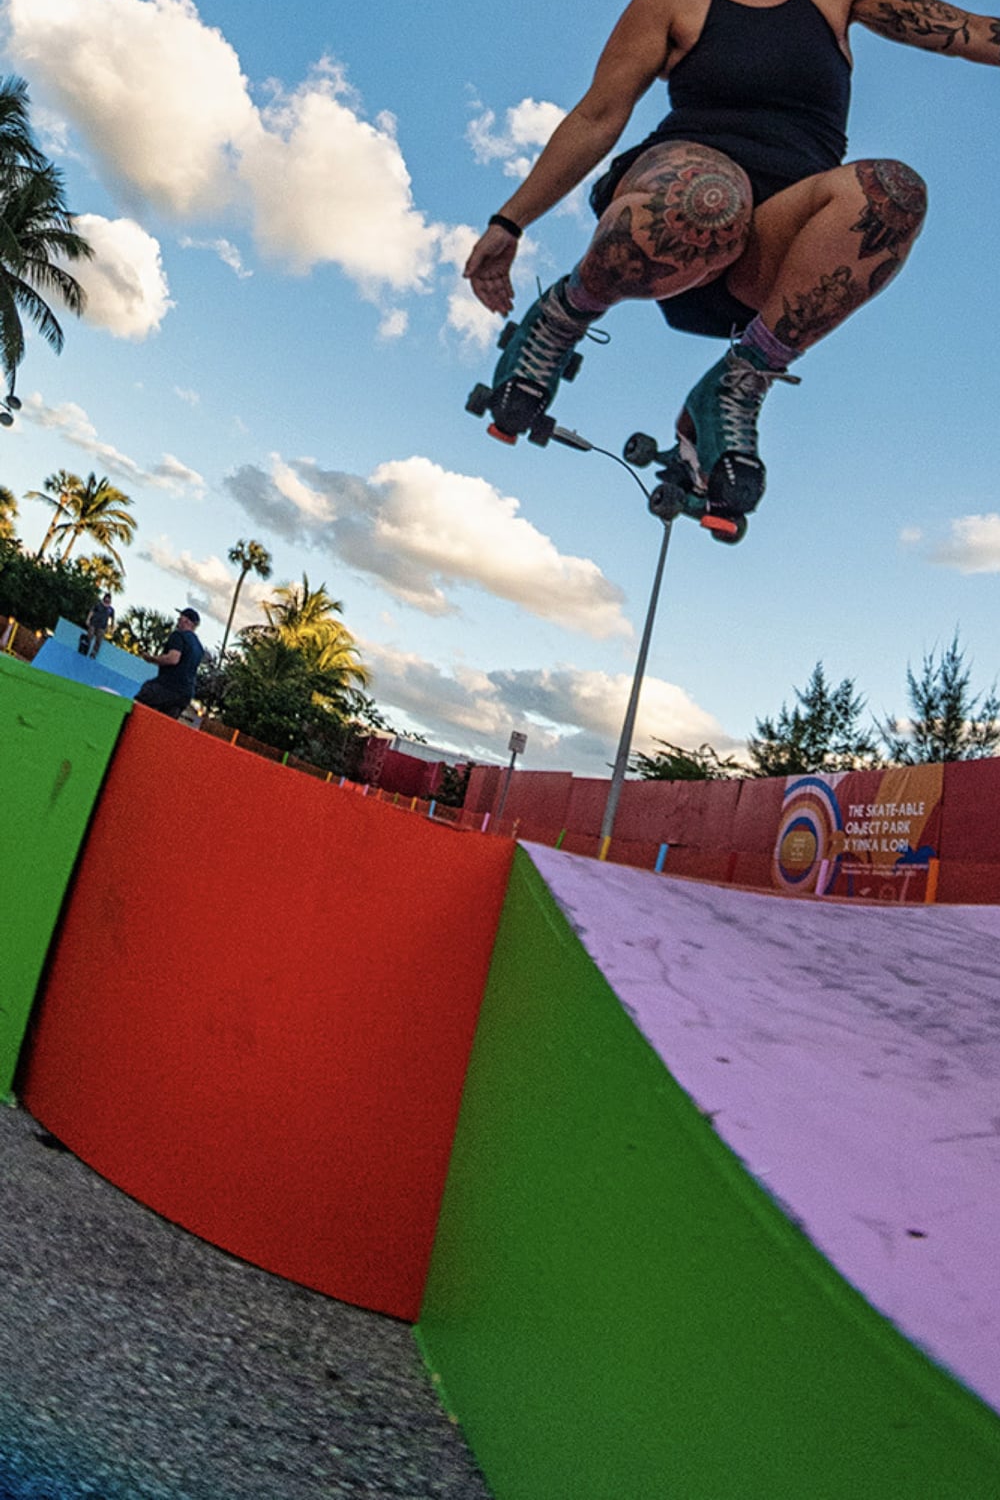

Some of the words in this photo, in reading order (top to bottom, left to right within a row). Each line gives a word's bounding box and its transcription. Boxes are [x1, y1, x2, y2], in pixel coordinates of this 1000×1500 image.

[848, 804, 865, 817] THE
[866, 802, 925, 817] SKATE-ABLE
[845, 821, 881, 835] OBJECT
[882, 820, 911, 835] PARK
[843, 839, 850, 851] X
[852, 838, 878, 851] YINKA
[881, 838, 909, 852] ILORI
